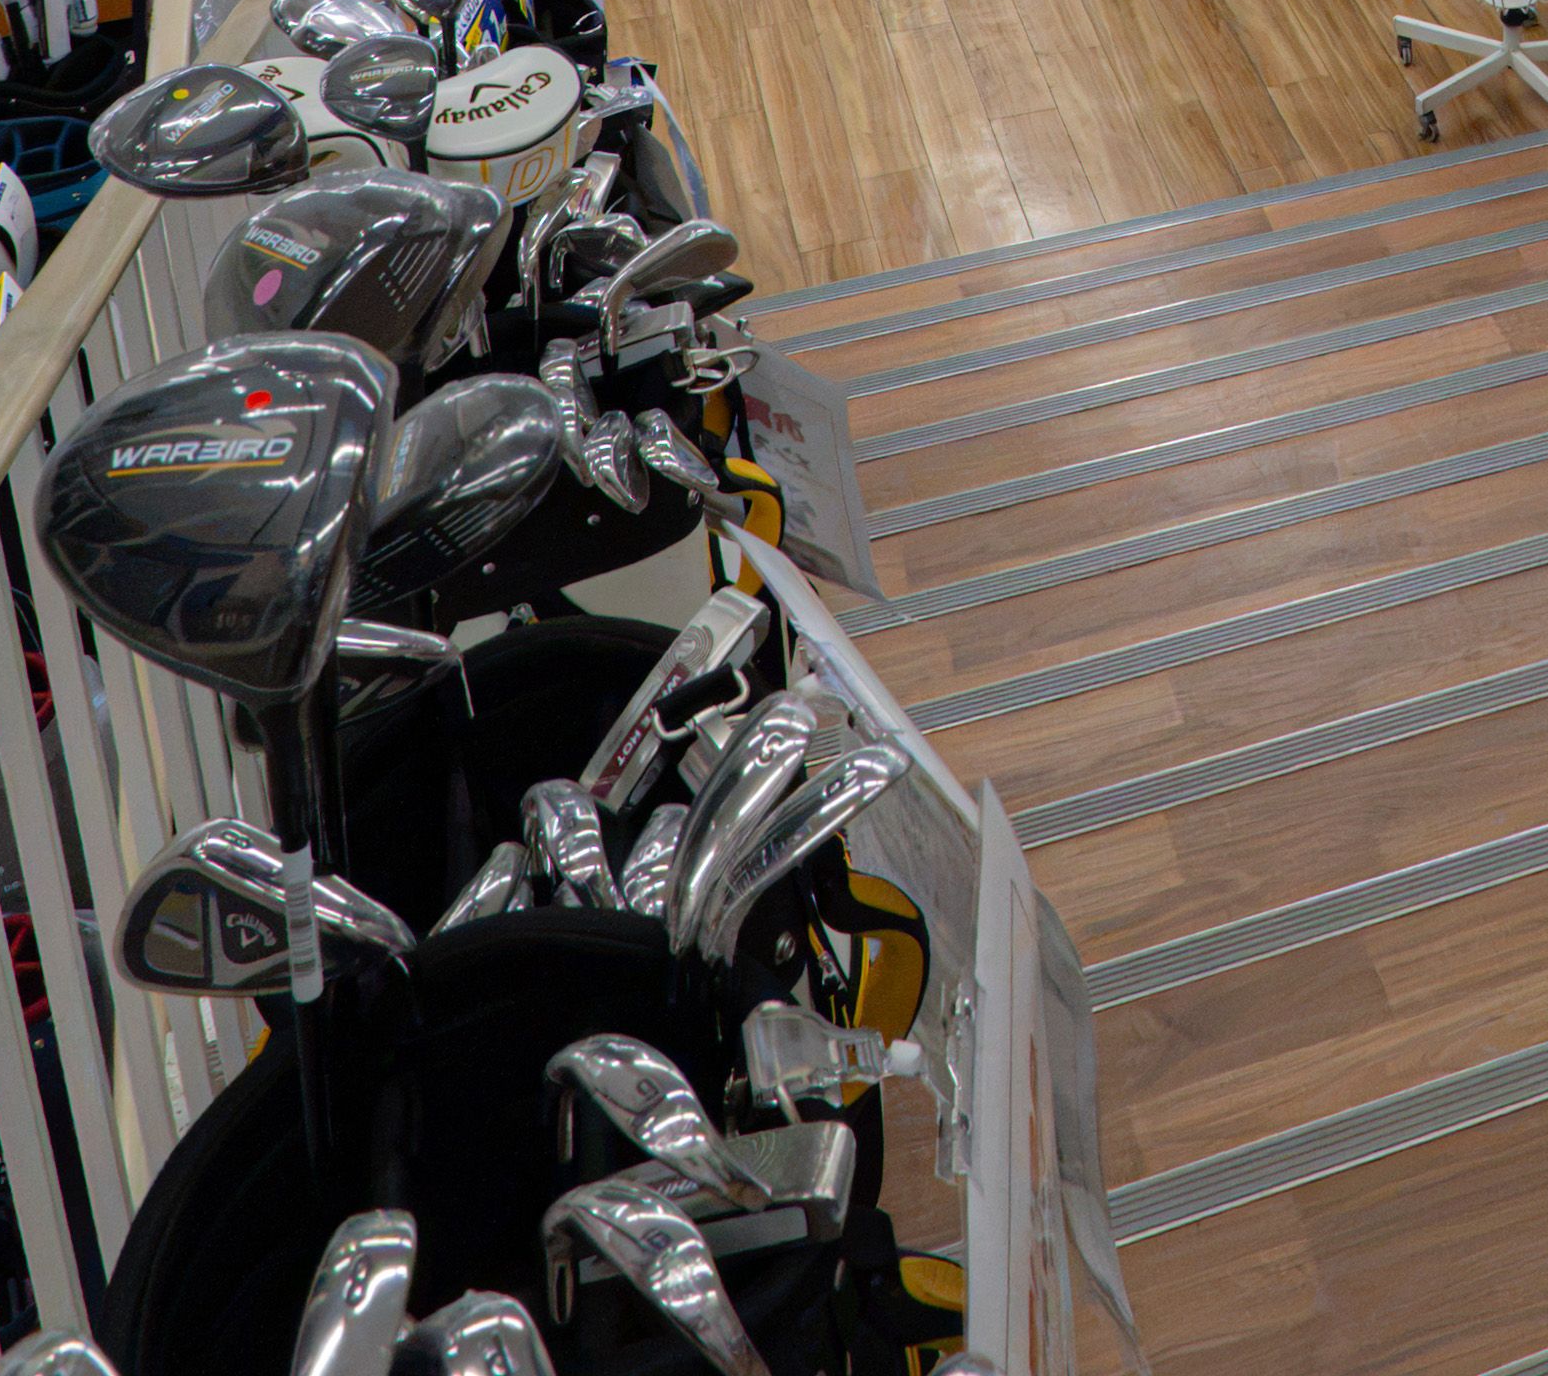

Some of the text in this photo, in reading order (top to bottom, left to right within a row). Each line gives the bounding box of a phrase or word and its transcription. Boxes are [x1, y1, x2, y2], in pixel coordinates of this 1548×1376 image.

[435, 71, 552, 125] Callaway
[241, 225, 322, 267] WARBIRD
[110, 436, 294, 470] WARBIRD
